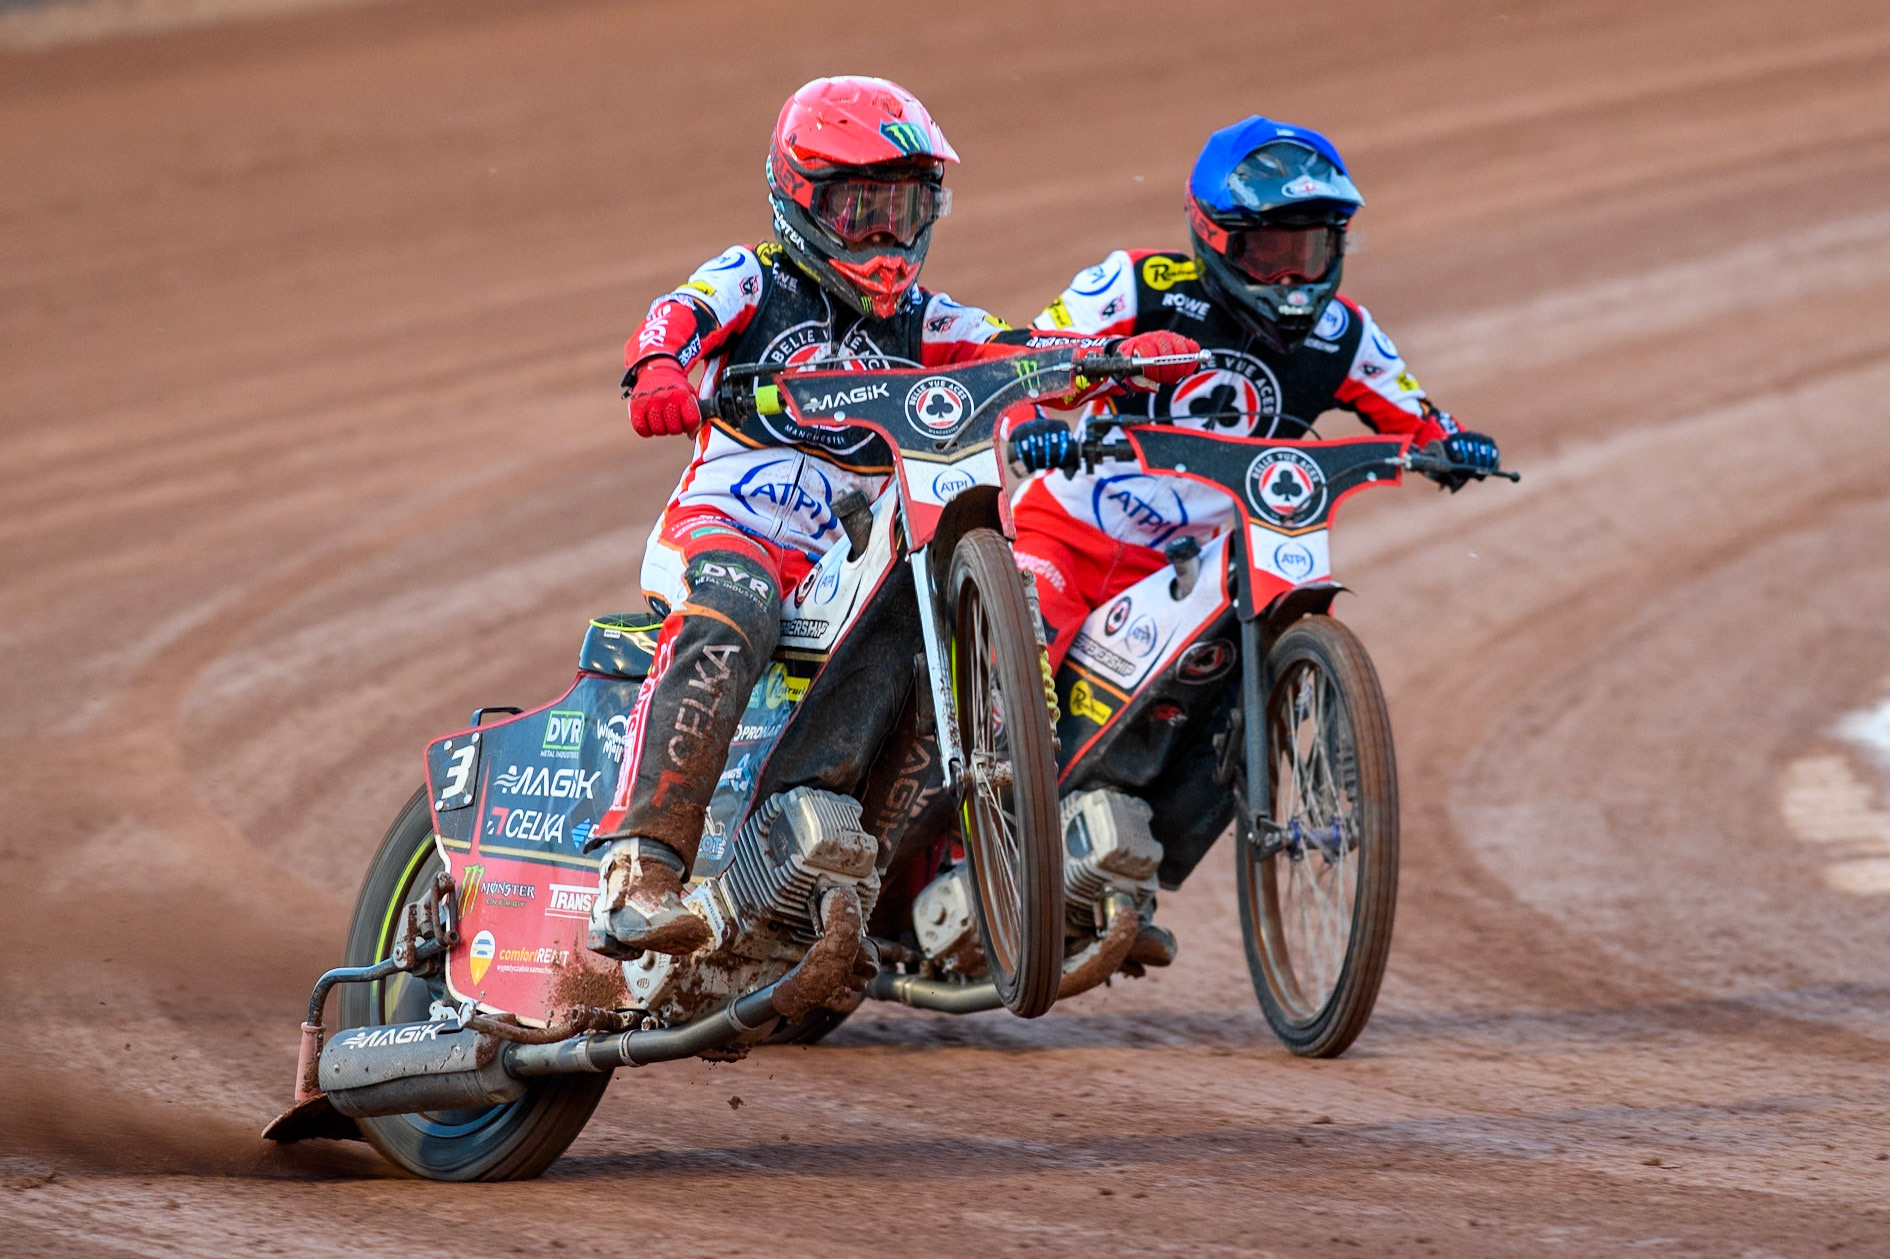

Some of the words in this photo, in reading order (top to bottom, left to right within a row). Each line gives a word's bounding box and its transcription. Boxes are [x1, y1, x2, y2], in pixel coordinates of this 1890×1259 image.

[1161, 292, 1211, 316] ROWE
[771, 329, 815, 364] BELLE
[908, 384, 927, 406] BELLE
[928, 380, 946, 388] VUE
[948, 384, 967, 400] ACES
[1224, 355, 1255, 376] VUE
[1255, 377, 1275, 414] ACES
[1252, 454, 1276, 480] BELLE
[1277, 452, 1299, 461] VUE
[1299, 460, 1320, 482] ACES
[750, 482, 823, 520] ATPI
[940, 479, 969, 495] ATPI
[1281, 553, 1307, 566] ATPI
[694, 575, 720, 586] METAL
[701, 562, 769, 601] DVR
[667, 644, 742, 767] CELKA
[546, 717, 582, 744] DVR
[440, 744, 476, 800] 3
[494, 765, 602, 799] MAGIK
[505, 808, 566, 844] CELKA
[481, 880, 535, 899] MONSTER
[486, 898, 527, 908] ENERGY
[341, 1022, 446, 1050] MAGIK
